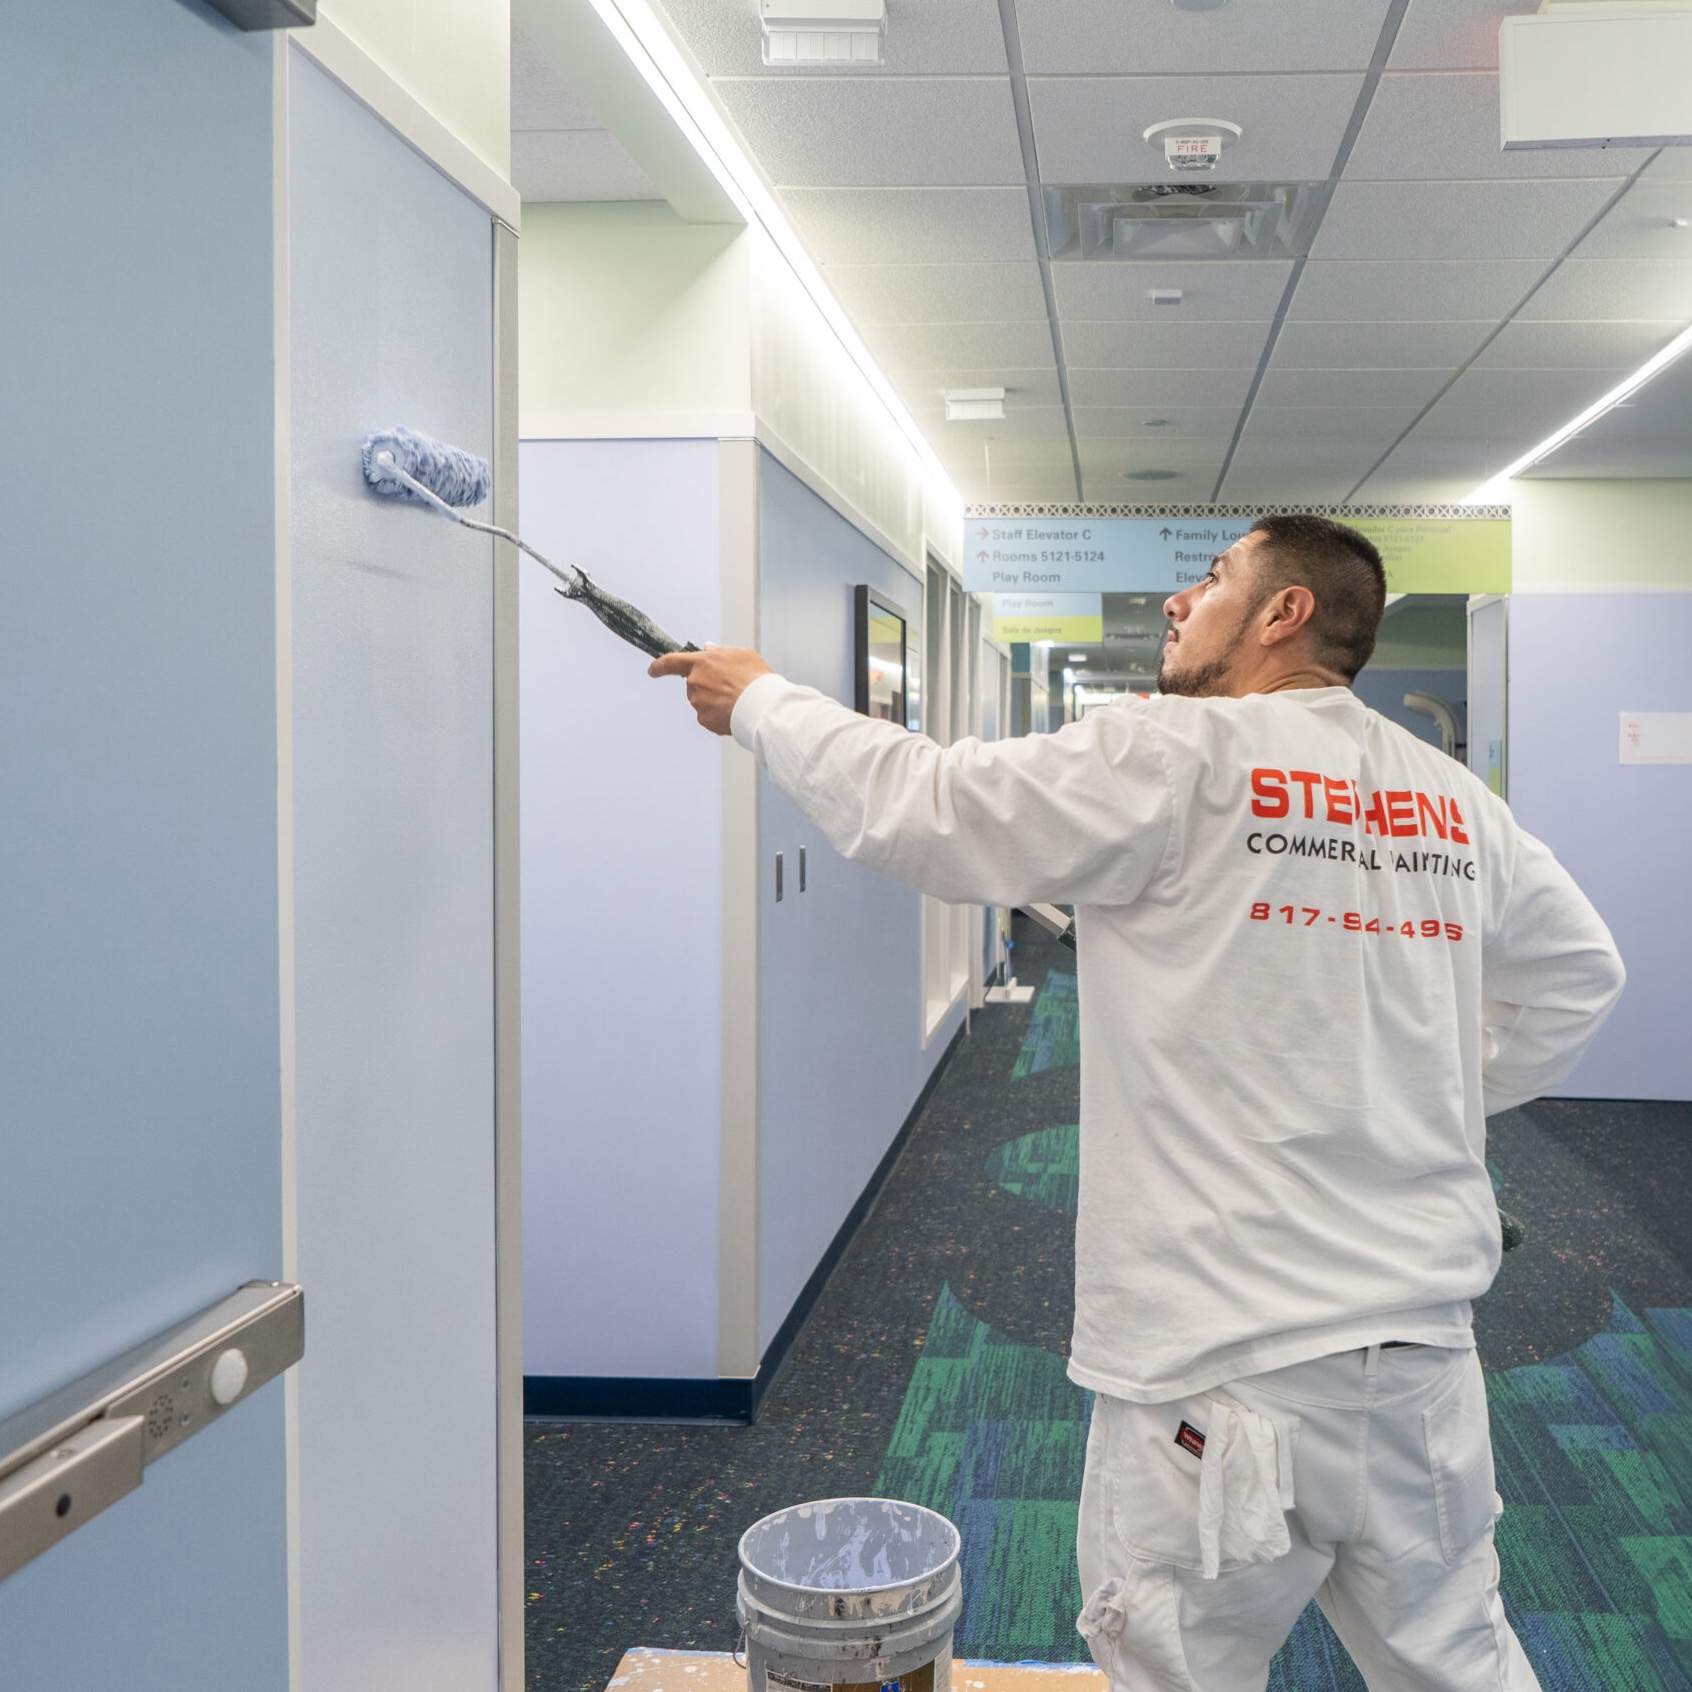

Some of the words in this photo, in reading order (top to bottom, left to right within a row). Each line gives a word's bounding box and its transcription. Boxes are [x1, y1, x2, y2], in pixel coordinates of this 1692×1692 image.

[1177, 144, 1208, 153] FIRE
[992, 529, 1022, 540] Staff
[1026, 529, 1078, 540] Elevator
[1082, 529, 1092, 540] C
[1176, 529, 1217, 542] Family
[993, 551, 1037, 562] Rooms
[1041, 551, 1105, 562] 5121-5124
[993, 571, 1019, 584] Play
[1023, 571, 1061, 583] Room
[1002, 599, 1022, 609] Play
[1025, 599, 1053, 608] Room
